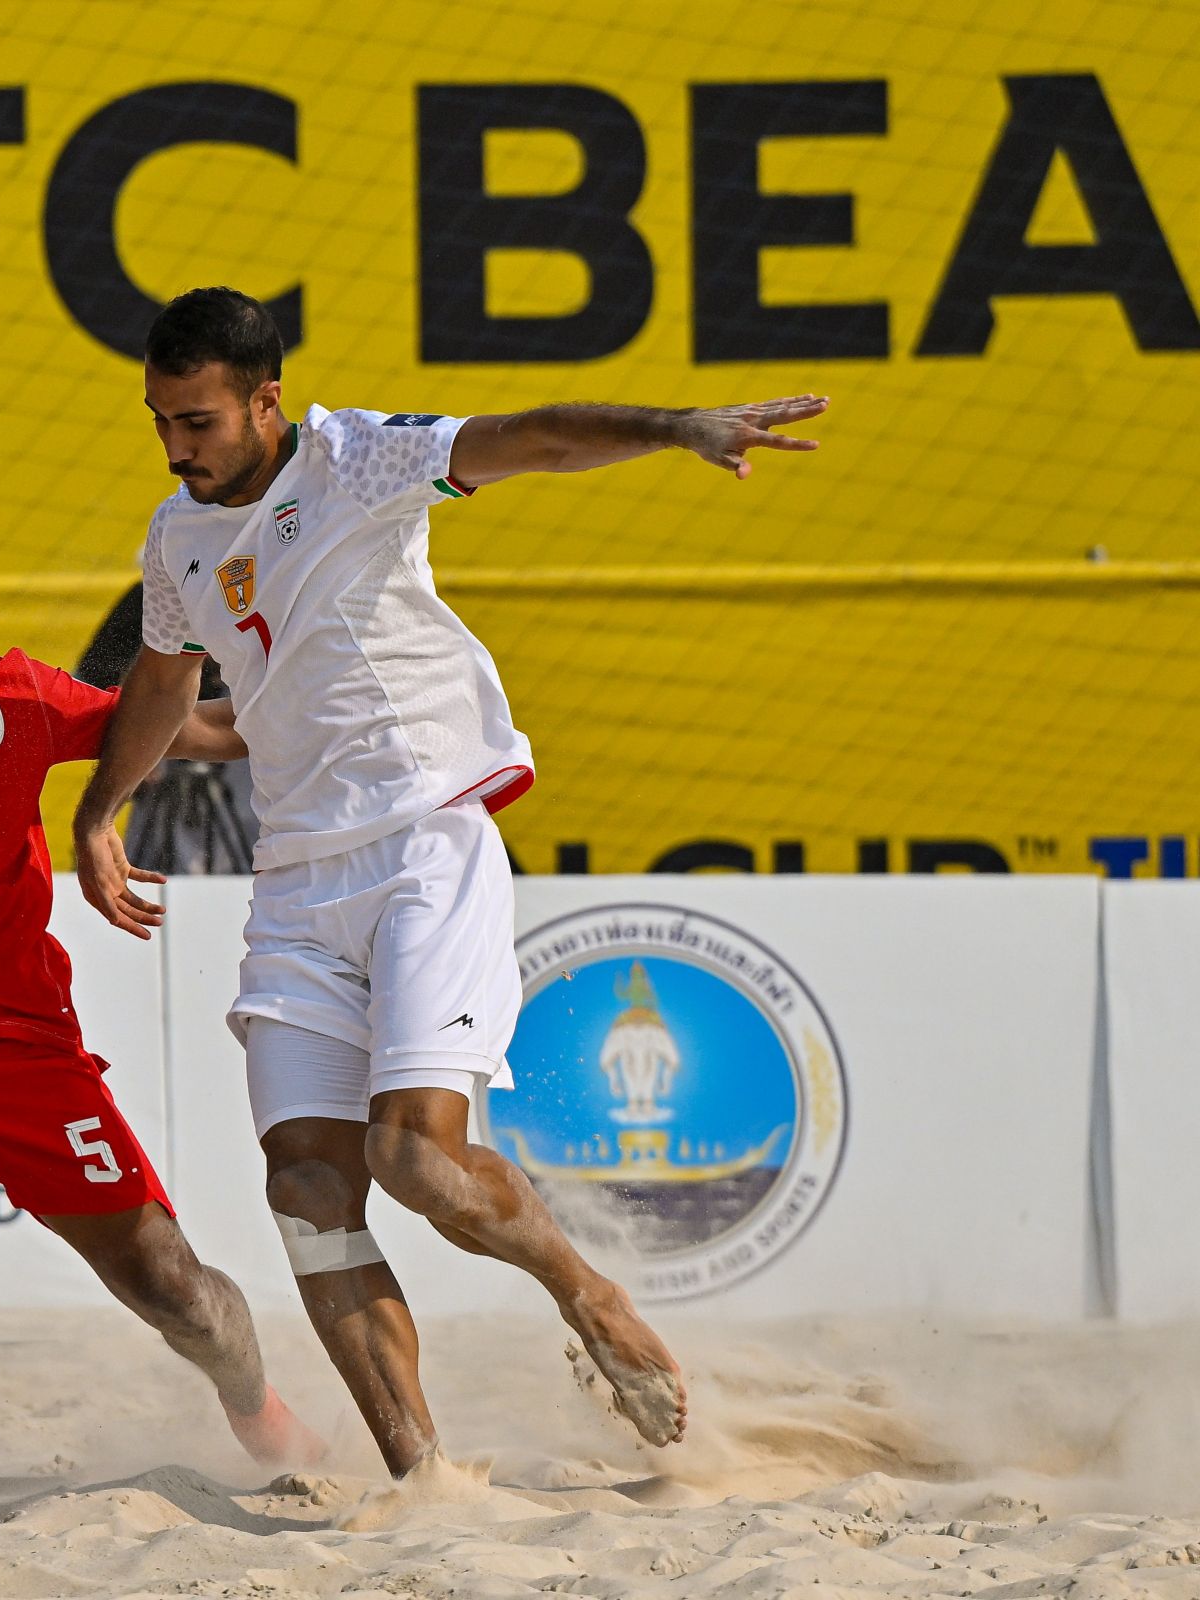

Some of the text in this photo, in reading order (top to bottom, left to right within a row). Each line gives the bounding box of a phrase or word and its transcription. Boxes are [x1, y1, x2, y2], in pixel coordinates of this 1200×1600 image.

[414, 71, 1200, 365] BEA
[234, 611, 273, 672] 7
[63, 1116, 123, 1183] 5
